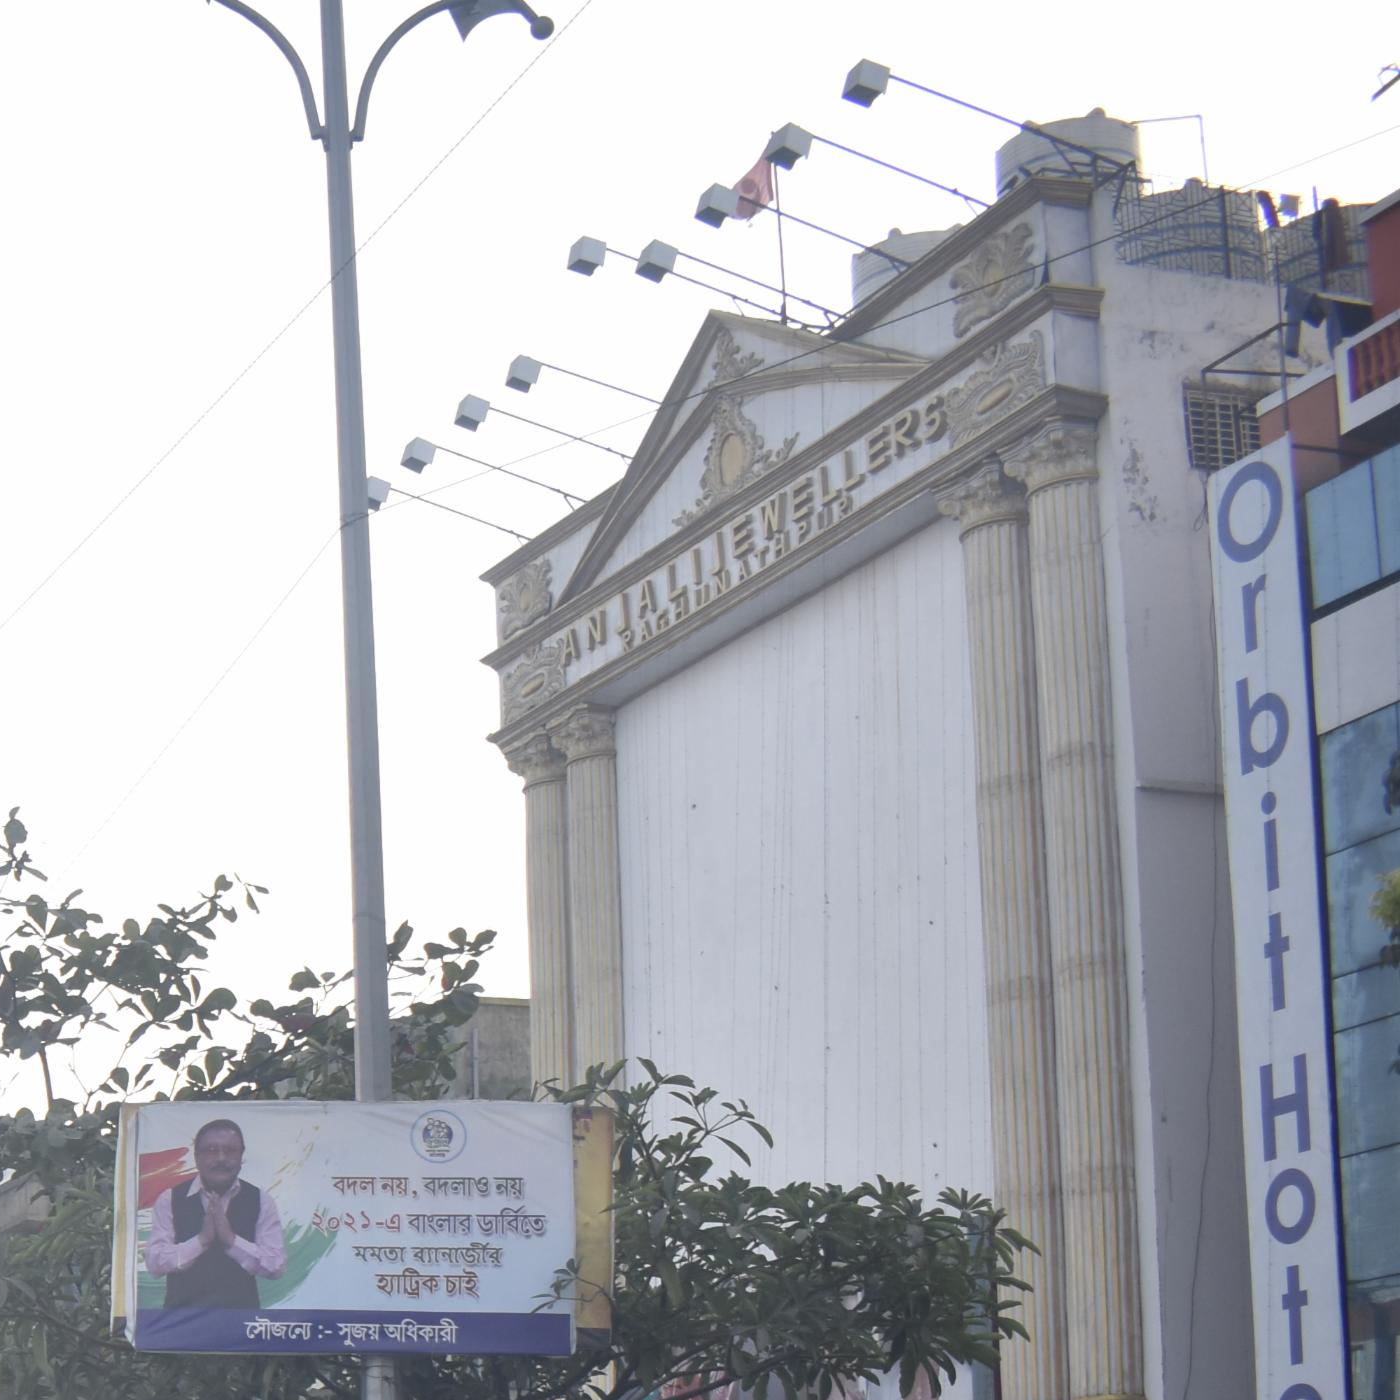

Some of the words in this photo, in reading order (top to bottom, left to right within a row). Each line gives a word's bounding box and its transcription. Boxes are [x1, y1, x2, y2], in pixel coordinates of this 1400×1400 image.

[559, 549, 702, 667] ANJALI
[711, 395, 946, 577] JEWELLERS
[621, 496, 855, 655] RAGHUNATHPUR
[1216, 460, 1292, 1012] Orbit
[332, 1176, 376, 1197] বদল
[423, 1176, 489, 1197] বদলাও
[494, 1176, 524, 1199] নয়
[406, 1213, 472, 1235] বাংলার
[475, 1205, 547, 1237] ডার্বিতে
[352, 1245, 407, 1264] মমতা
[443, 1268, 481, 1299] চাই
[244, 1319, 312, 1342] সৌজন্যে
[338, 1321, 380, 1348] সুজয়
[384, 1318, 460, 1344] অধিকারী
